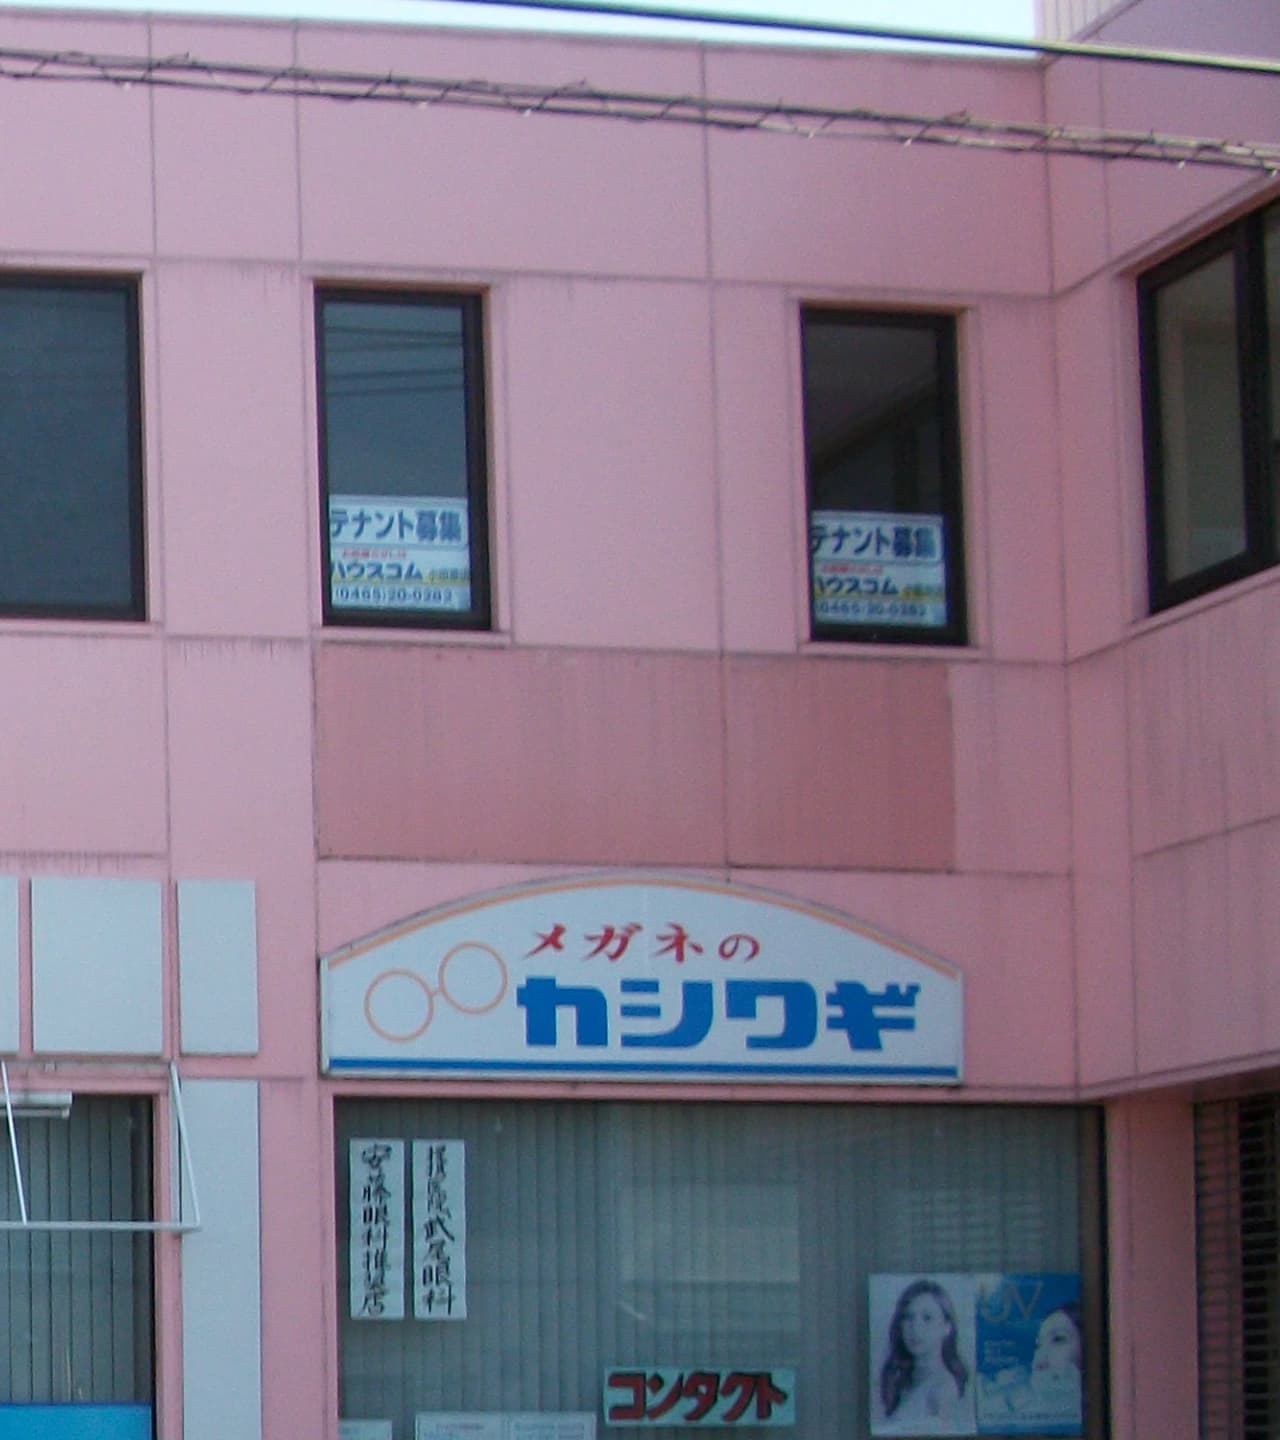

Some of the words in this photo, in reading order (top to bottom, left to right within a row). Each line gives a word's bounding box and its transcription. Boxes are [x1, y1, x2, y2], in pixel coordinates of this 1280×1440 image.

[330, 509, 461, 541] テナント募集
[523, 922, 761, 963] メガネの
[516, 976, 921, 1051] カシワギ
[607, 1371, 788, 1422] コンタクト
